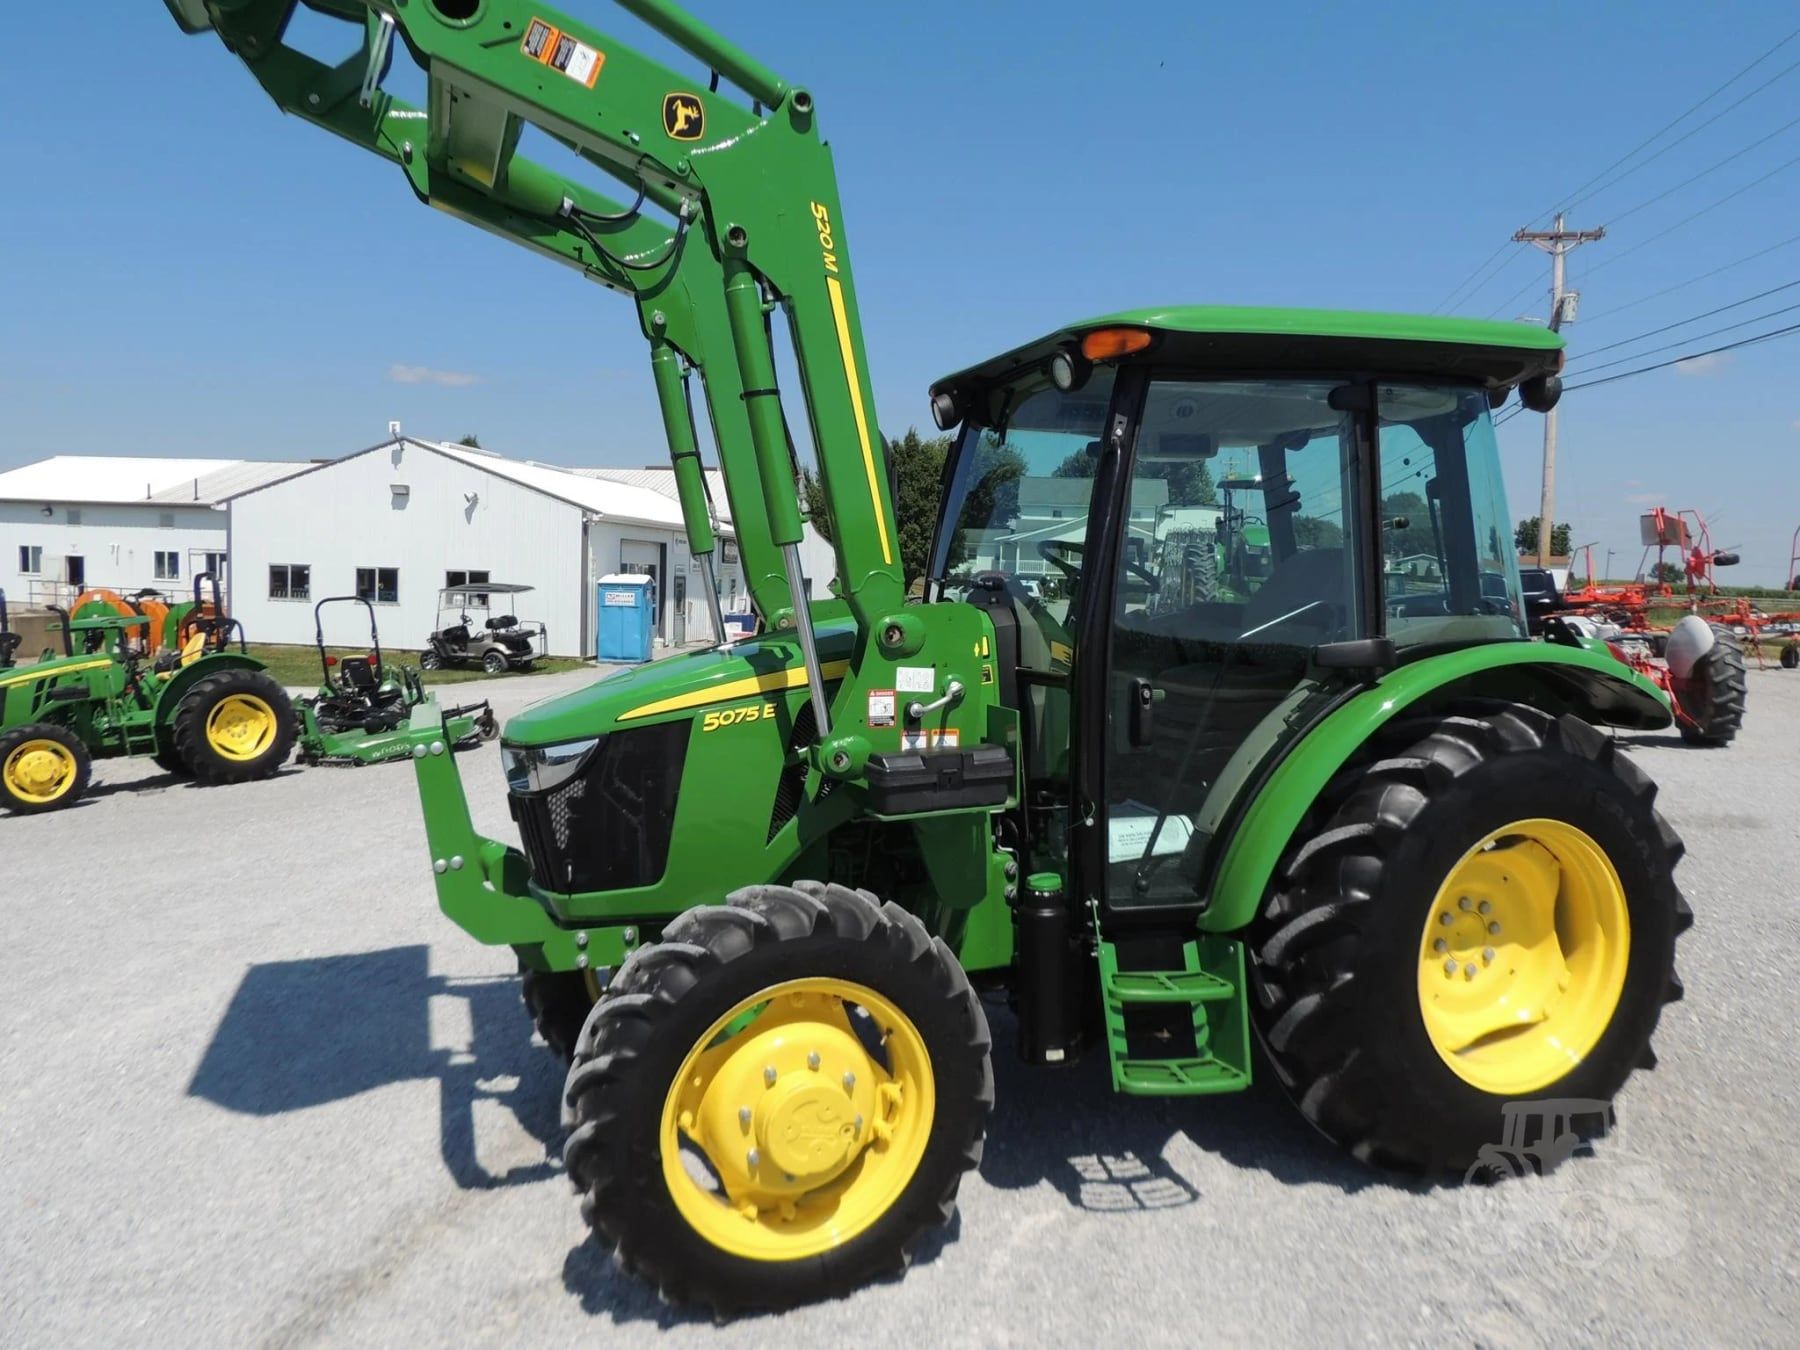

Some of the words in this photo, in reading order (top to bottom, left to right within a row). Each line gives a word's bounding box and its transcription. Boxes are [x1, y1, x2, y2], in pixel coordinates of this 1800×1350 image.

[810, 200, 834, 250] 520
[822, 251, 839, 273] M
[703, 705, 760, 733] 5075
[762, 702, 778, 719] E
